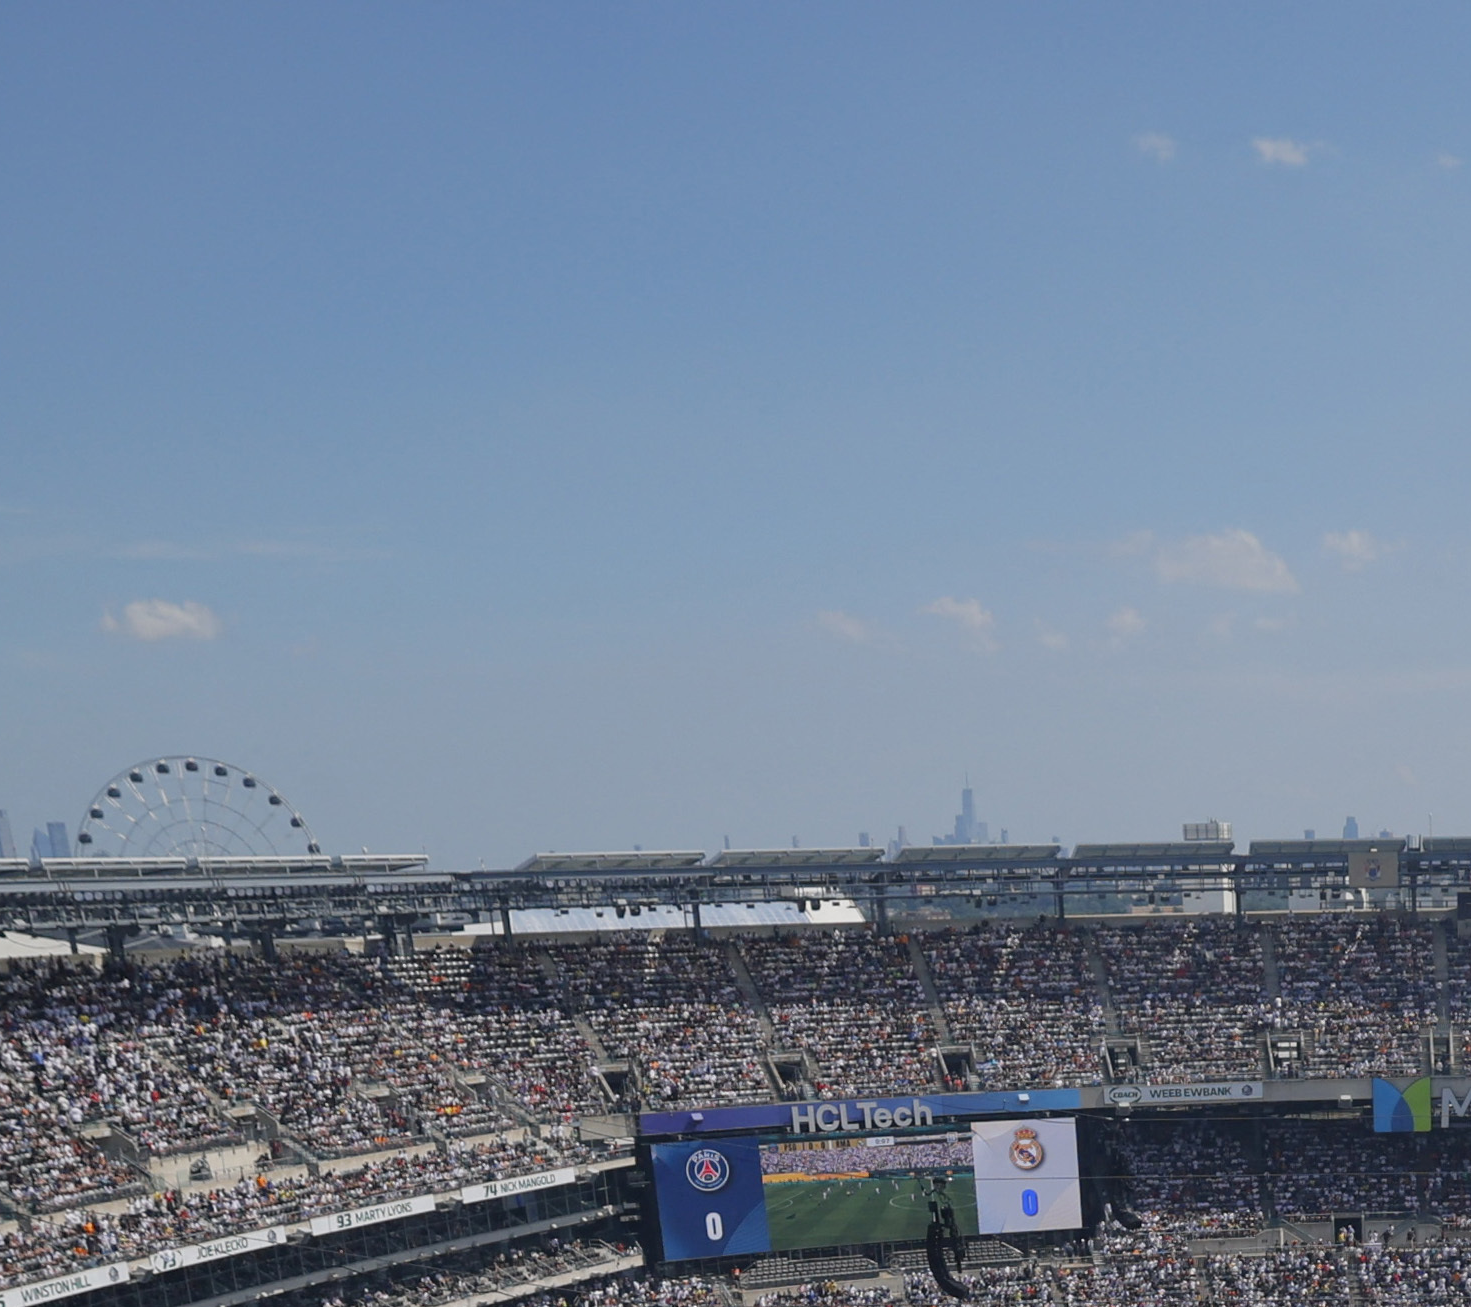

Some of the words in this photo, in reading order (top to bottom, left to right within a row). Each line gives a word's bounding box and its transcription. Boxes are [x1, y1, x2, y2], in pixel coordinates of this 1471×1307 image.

[1149, 1088, 1182, 1098] WEEB
[1184, 1087, 1232, 1097] EWBANK
[791, 1099, 933, 1133] HCLTech
[693, 1149, 720, 1161] PARIS
[482, 1182, 498, 1198] 74
[500, 1180, 518, 1195] NICK
[518, 1173, 555, 1190] MANGOLD
[1021, 1188, 1039, 1217] 0
[335, 1212, 353, 1229] 93
[355, 1207, 384, 1225] MARTY
[384, 1202, 413, 1219] LYONS
[705, 1212, 723, 1241] 0
[196, 1246, 213, 1260] JOE
[212, 1238, 249, 1258] KLECKO
[21, 1278, 69, 1303] WINSTON
